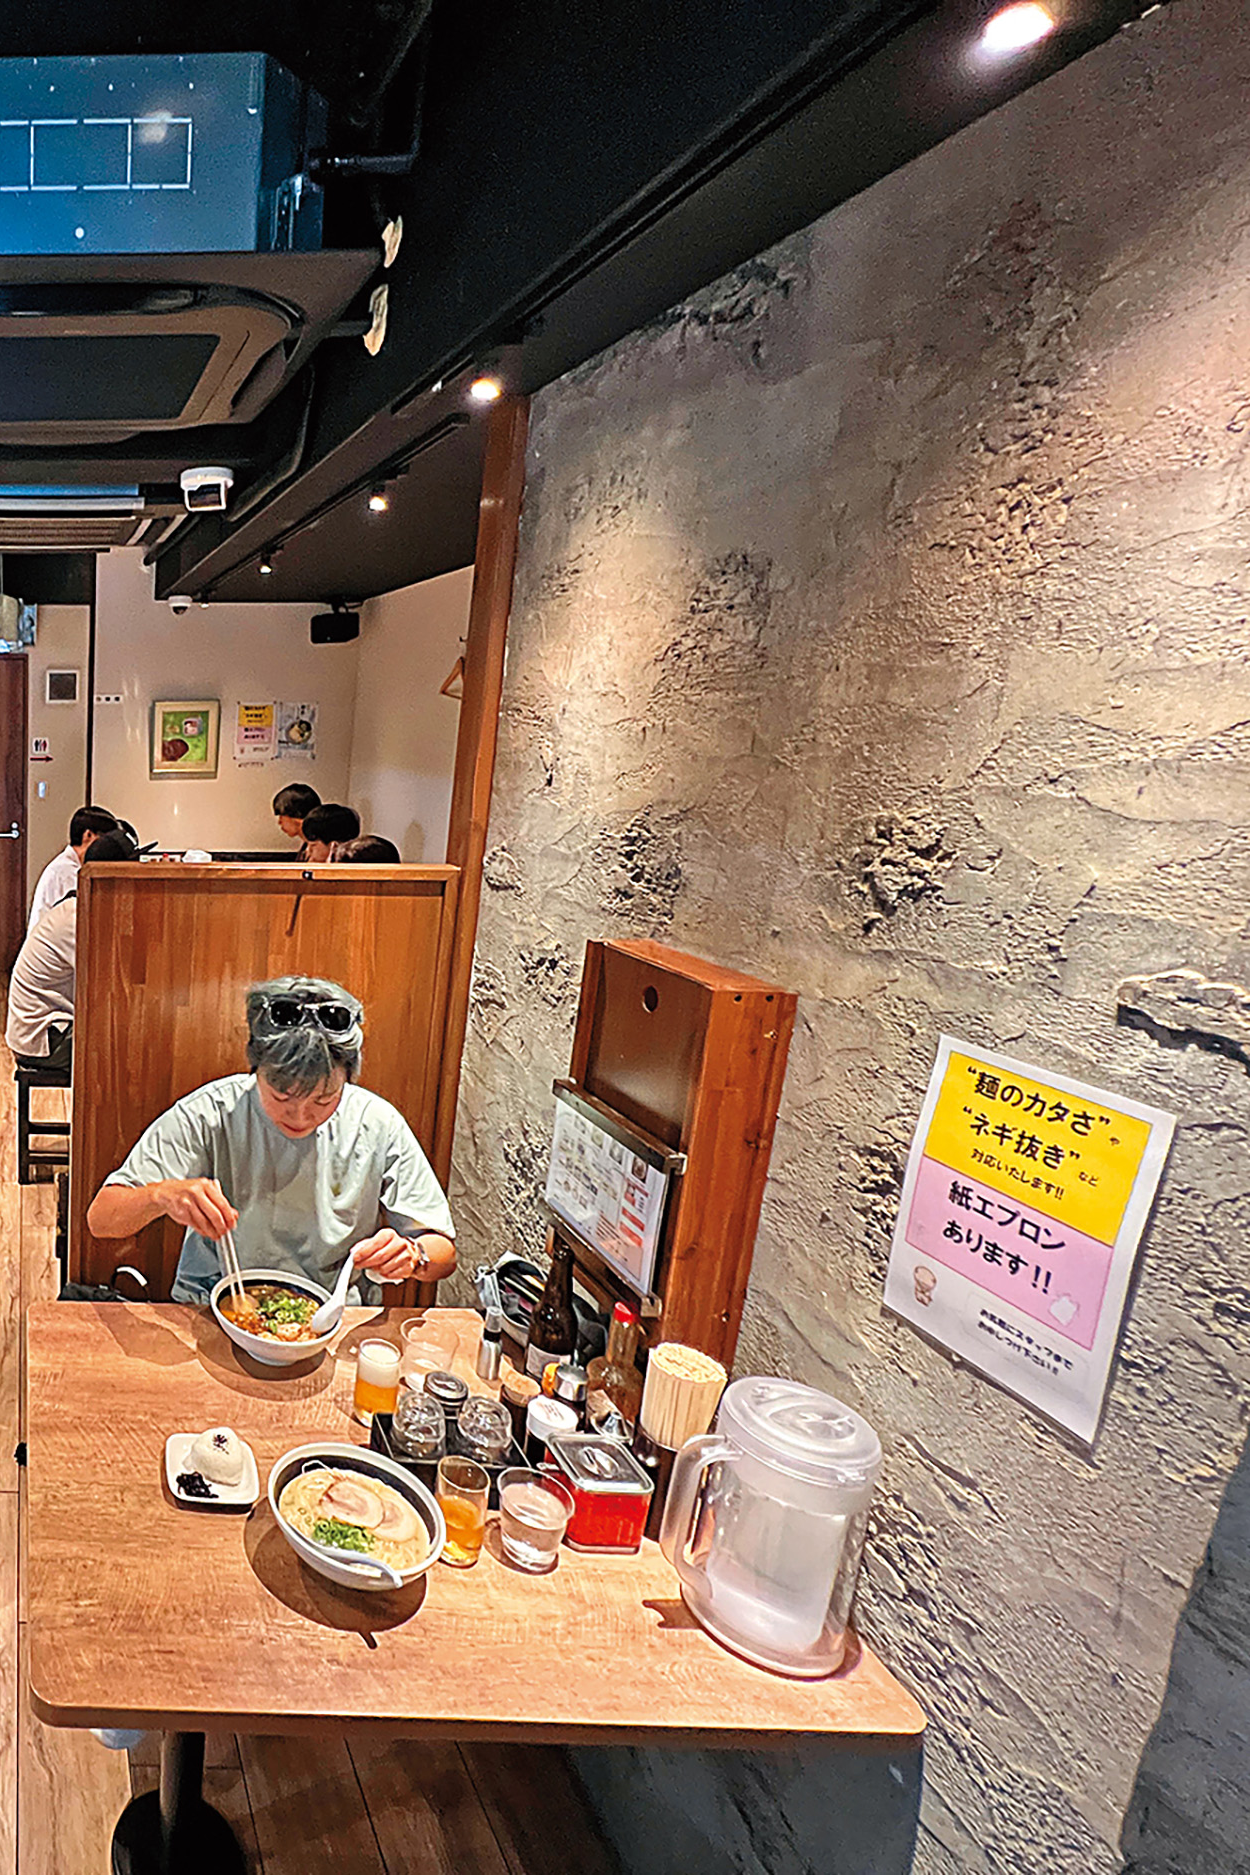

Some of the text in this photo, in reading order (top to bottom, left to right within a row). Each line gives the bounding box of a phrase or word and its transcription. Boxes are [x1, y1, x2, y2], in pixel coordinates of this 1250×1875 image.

[949, 1181, 1066, 1250] 紙エプロン
